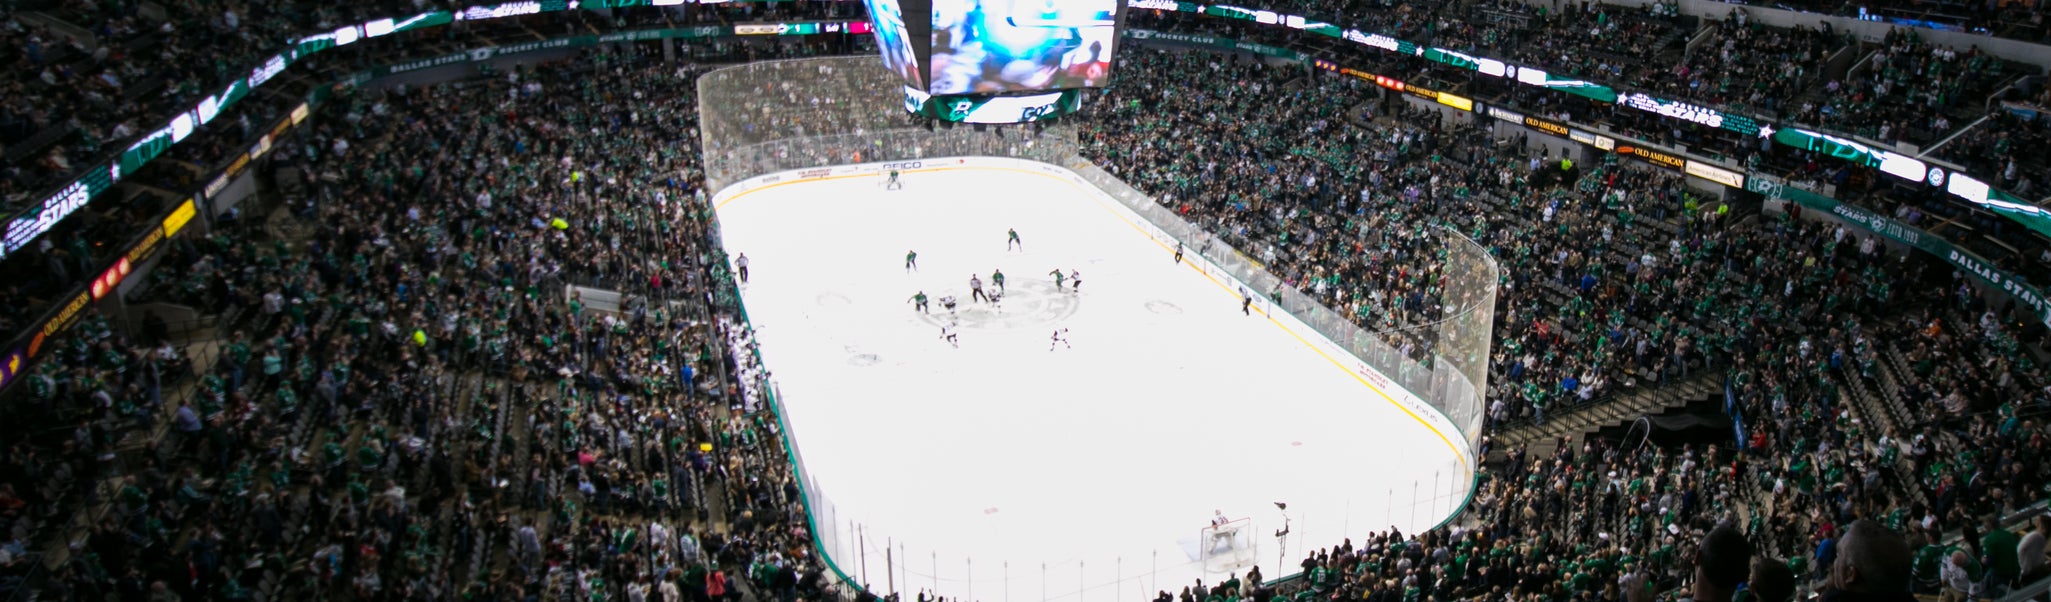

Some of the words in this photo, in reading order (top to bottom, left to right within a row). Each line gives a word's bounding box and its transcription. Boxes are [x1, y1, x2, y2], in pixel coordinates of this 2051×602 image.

[542, 39, 569, 48] CLUB
[1192, 36, 1214, 44] CLUB
[390, 60, 432, 73] DALLAS
[434, 54, 466, 65] STARS
[1526, 117, 1538, 127] OLD
[1538, 121, 1568, 135] AMERICAN
[1634, 147, 1649, 158] OLD
[1649, 151, 1685, 167] AMERICAN
[37, 184, 90, 232] STARS
[1833, 205, 1867, 223] STARS
[1949, 250, 2000, 284] DALLAS
[2003, 280, 2043, 311] STARS
